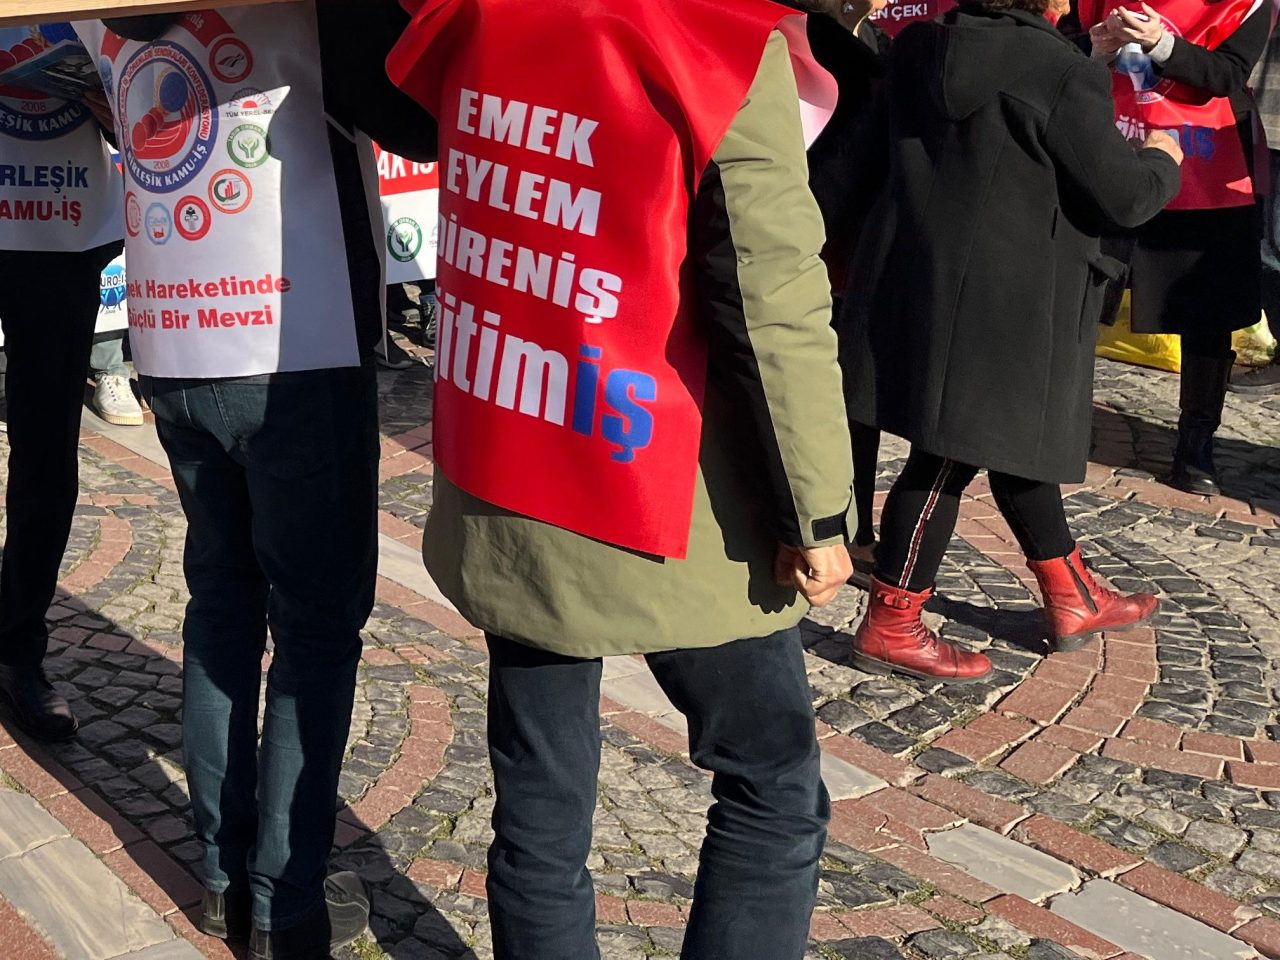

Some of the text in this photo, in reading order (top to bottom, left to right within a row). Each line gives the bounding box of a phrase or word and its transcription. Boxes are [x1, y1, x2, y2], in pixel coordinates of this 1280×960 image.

[891, 3, 928, 21] ÇEK!
[456, 87, 600, 168] EMEK
[164, 144, 209, 186] KAMU-İŞ
[446, 148, 602, 237] EYLEM
[146, 274, 291, 299] Hareketinde
[162, 309, 190, 330] Bir
[197, 305, 273, 329] Mevzi
